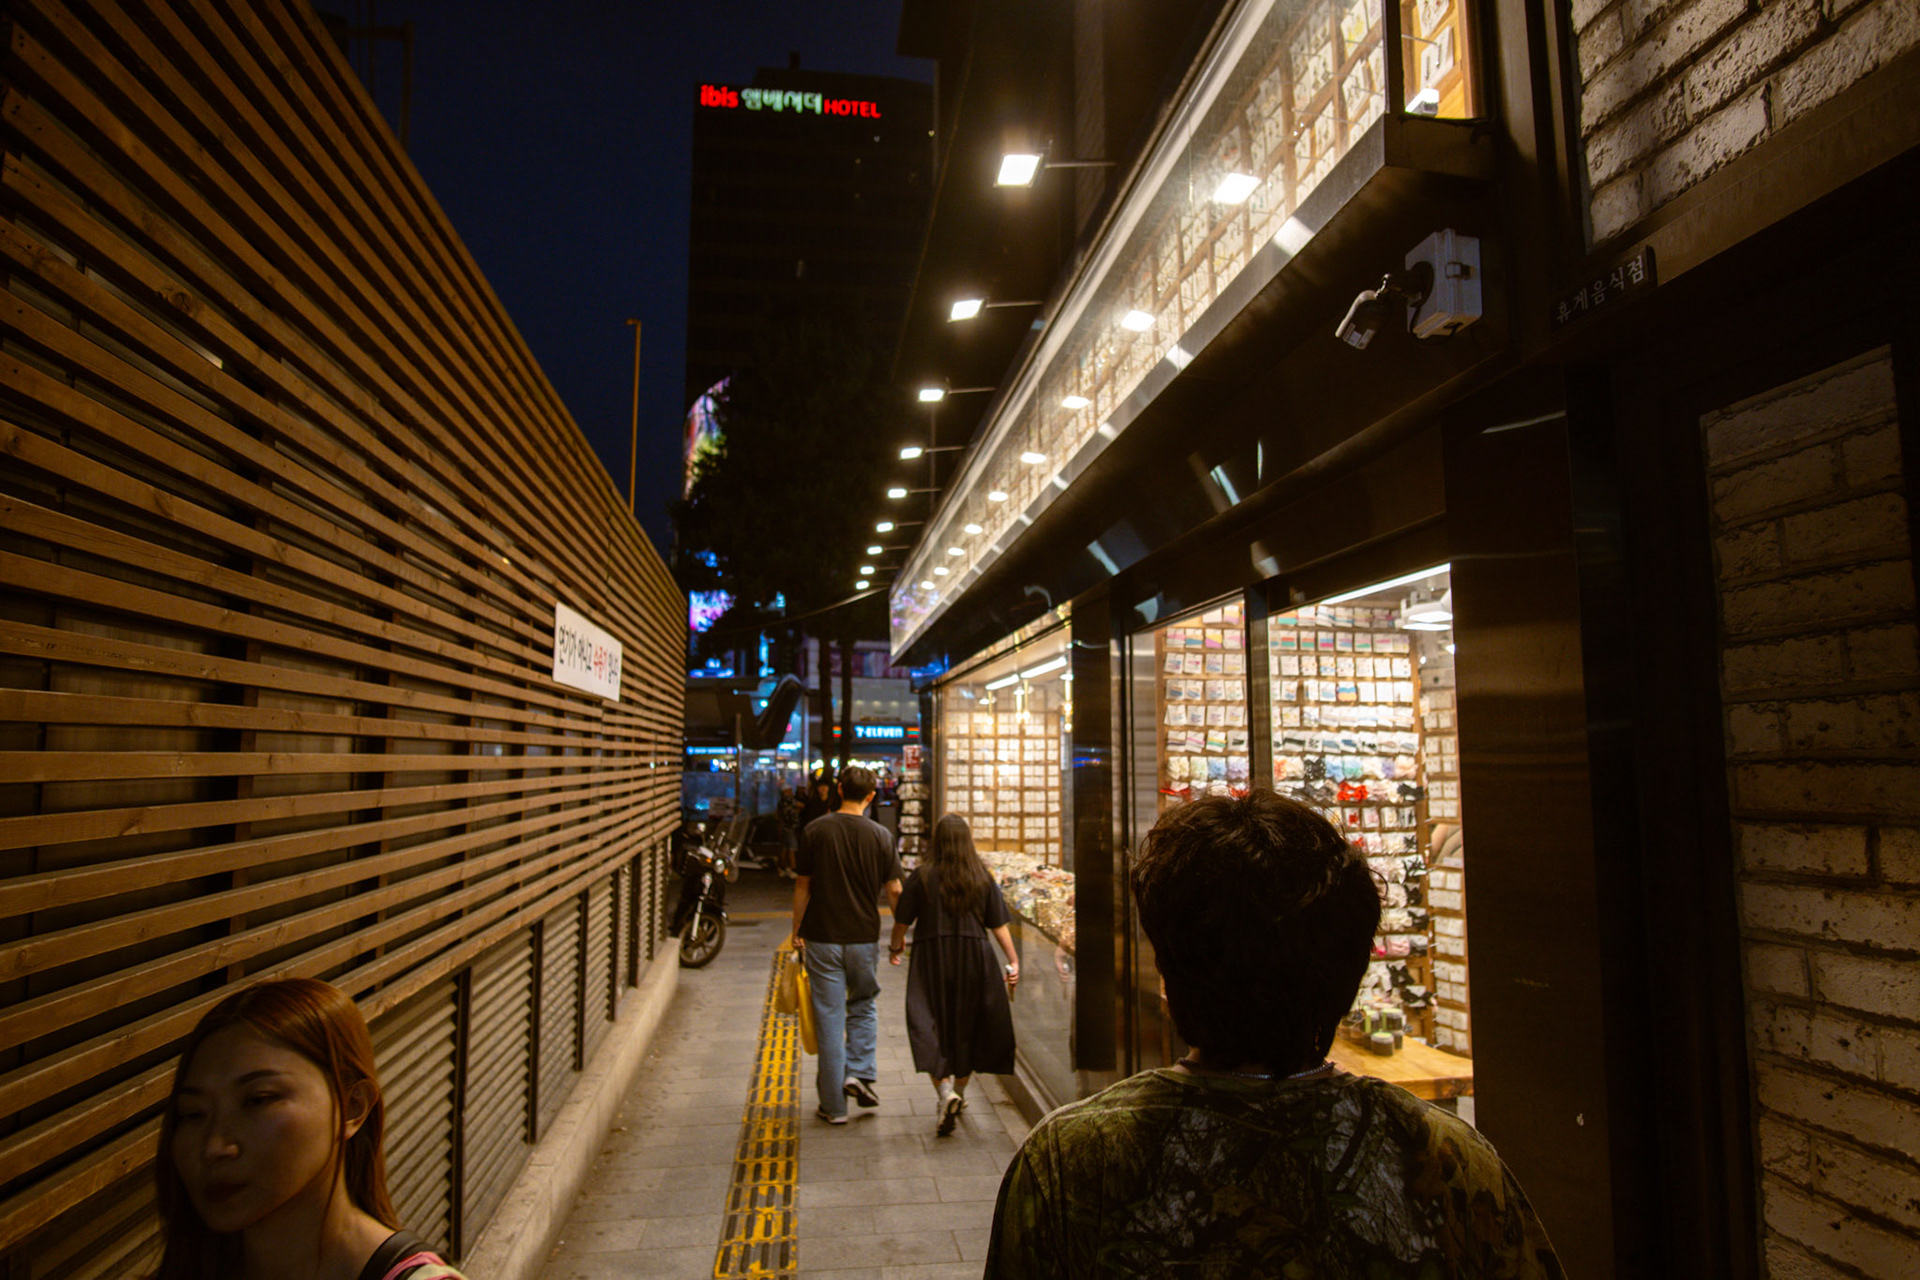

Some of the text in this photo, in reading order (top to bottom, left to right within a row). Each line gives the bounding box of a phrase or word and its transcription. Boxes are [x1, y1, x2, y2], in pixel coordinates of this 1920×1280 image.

[700, 85, 881, 118] ibis 앰배서더 HOTEL
[1556, 254, 1644, 324] 휴게음식점
